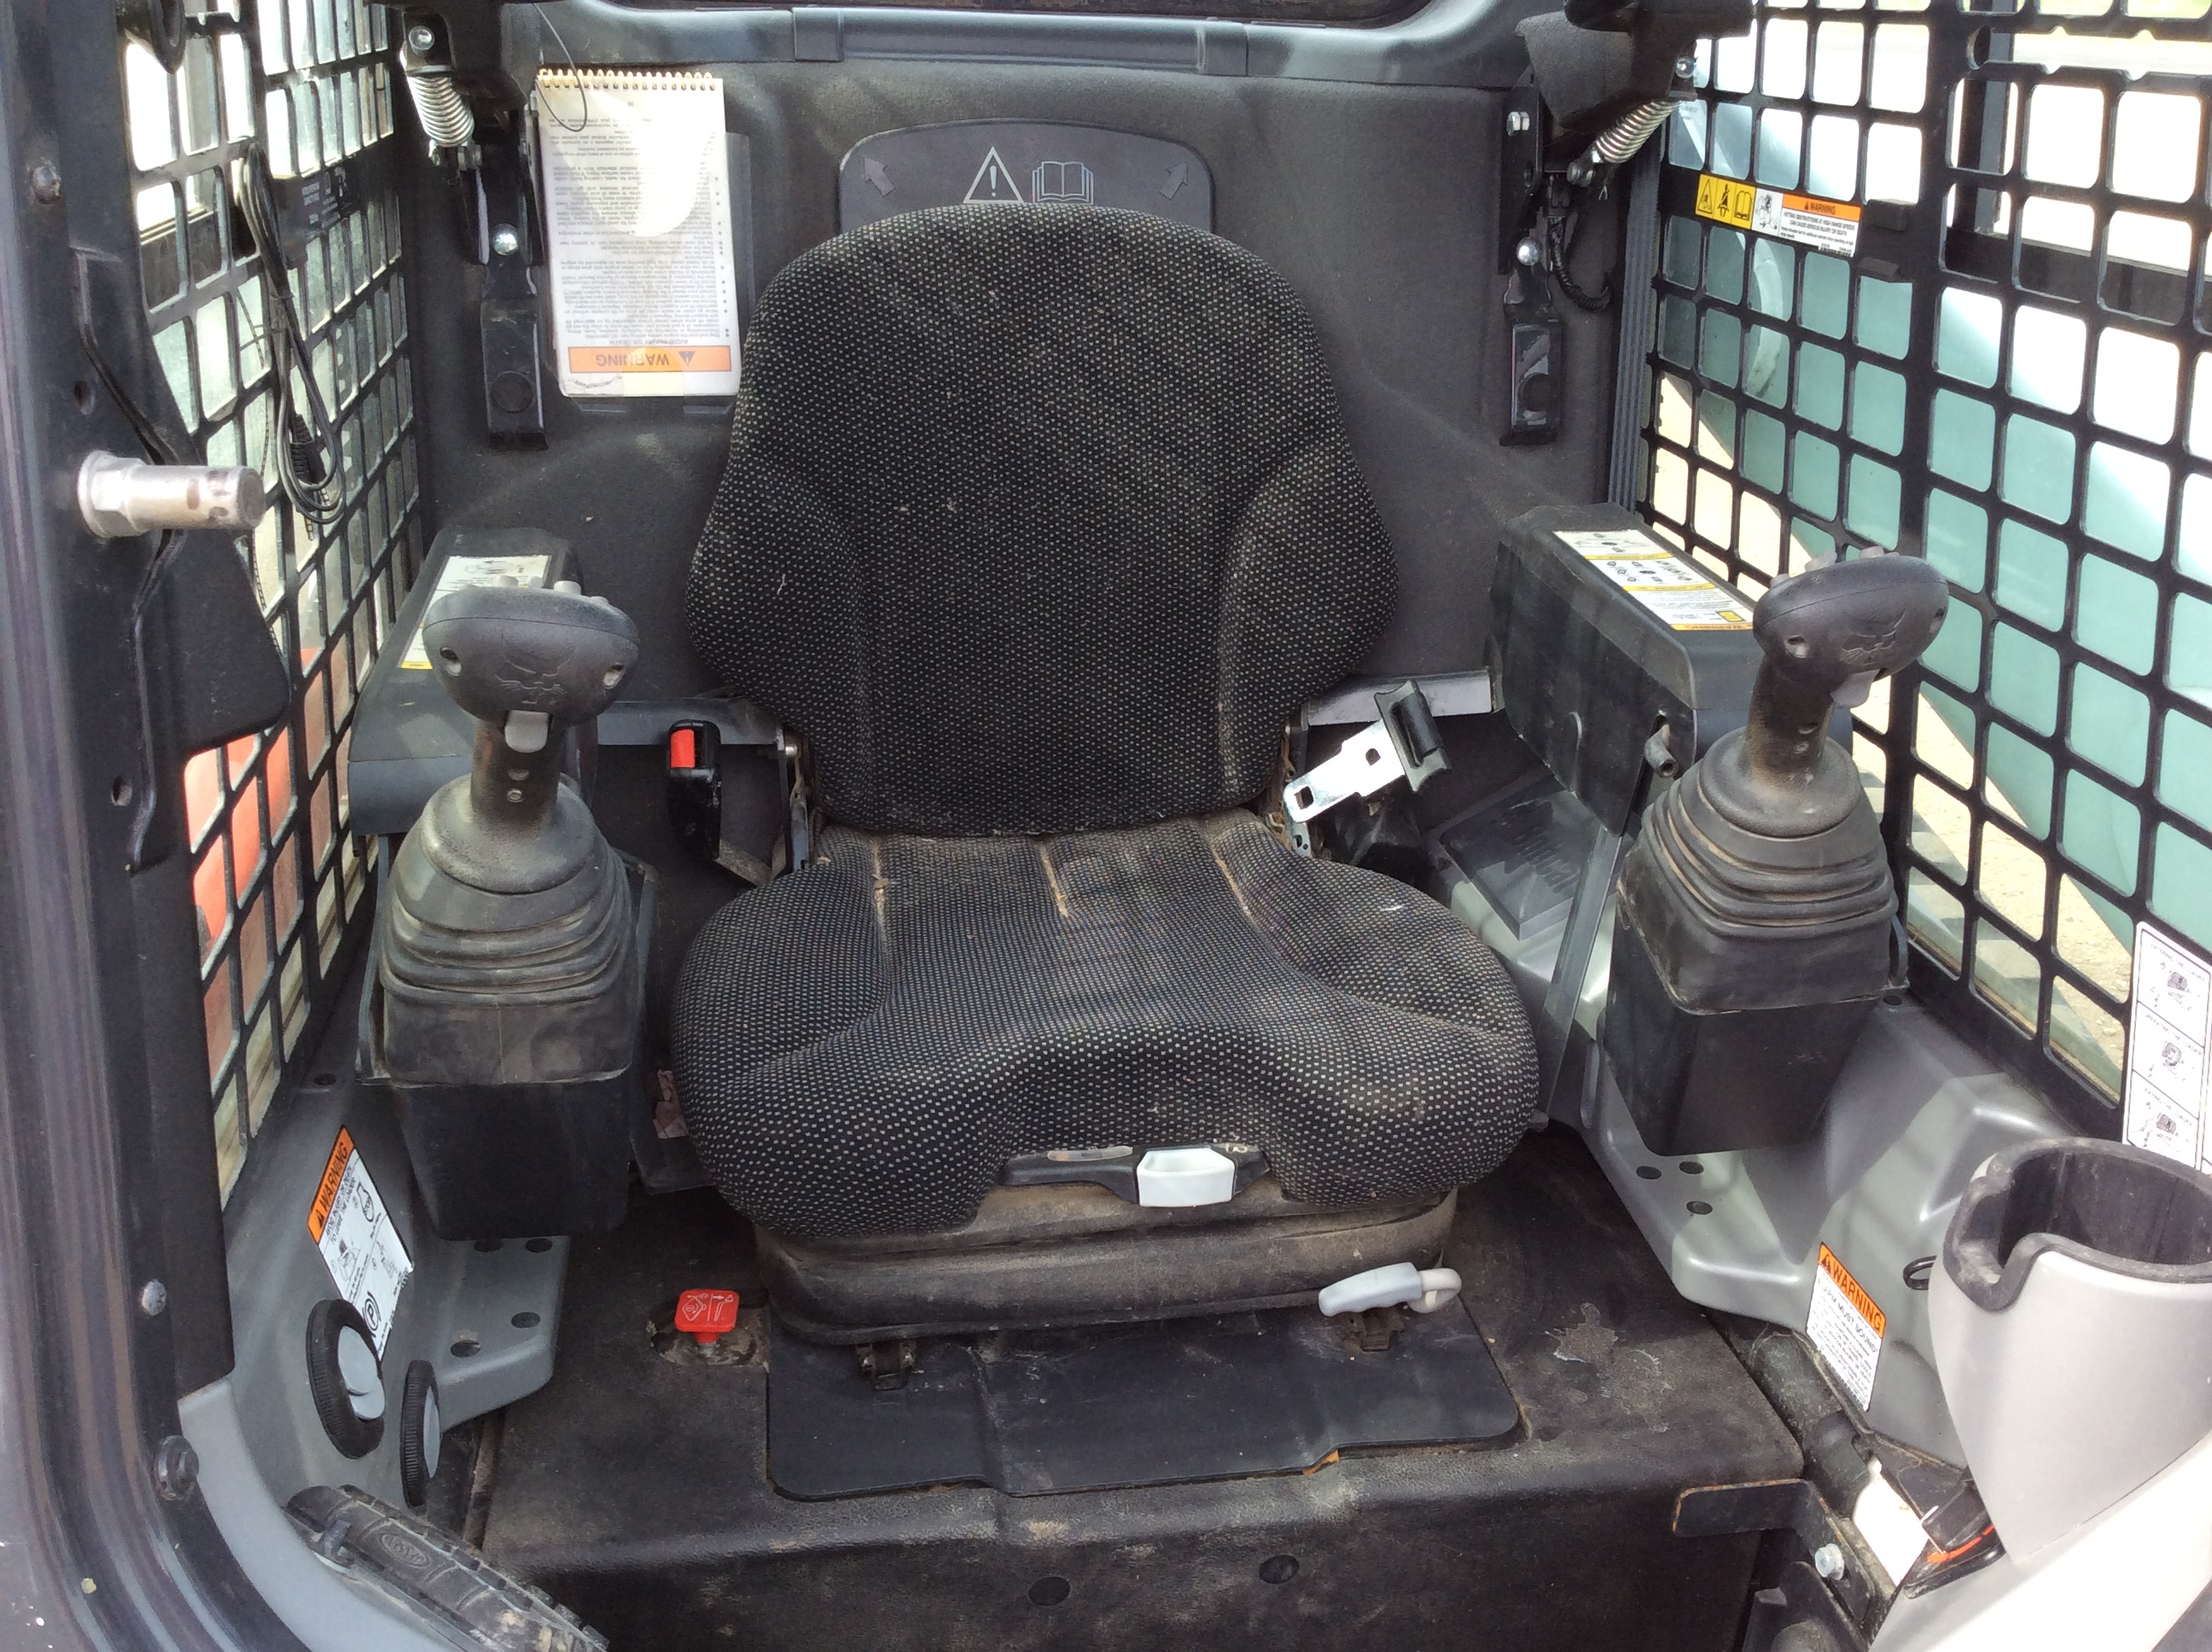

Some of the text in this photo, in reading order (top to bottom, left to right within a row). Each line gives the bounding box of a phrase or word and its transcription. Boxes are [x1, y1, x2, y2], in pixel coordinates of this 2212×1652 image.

[1810, 203, 1835, 214] WARNING
[595, 351, 671, 367] WARNING
[320, 1143, 347, 1210] WARNING
[1834, 1265, 1881, 1330] WARNING
